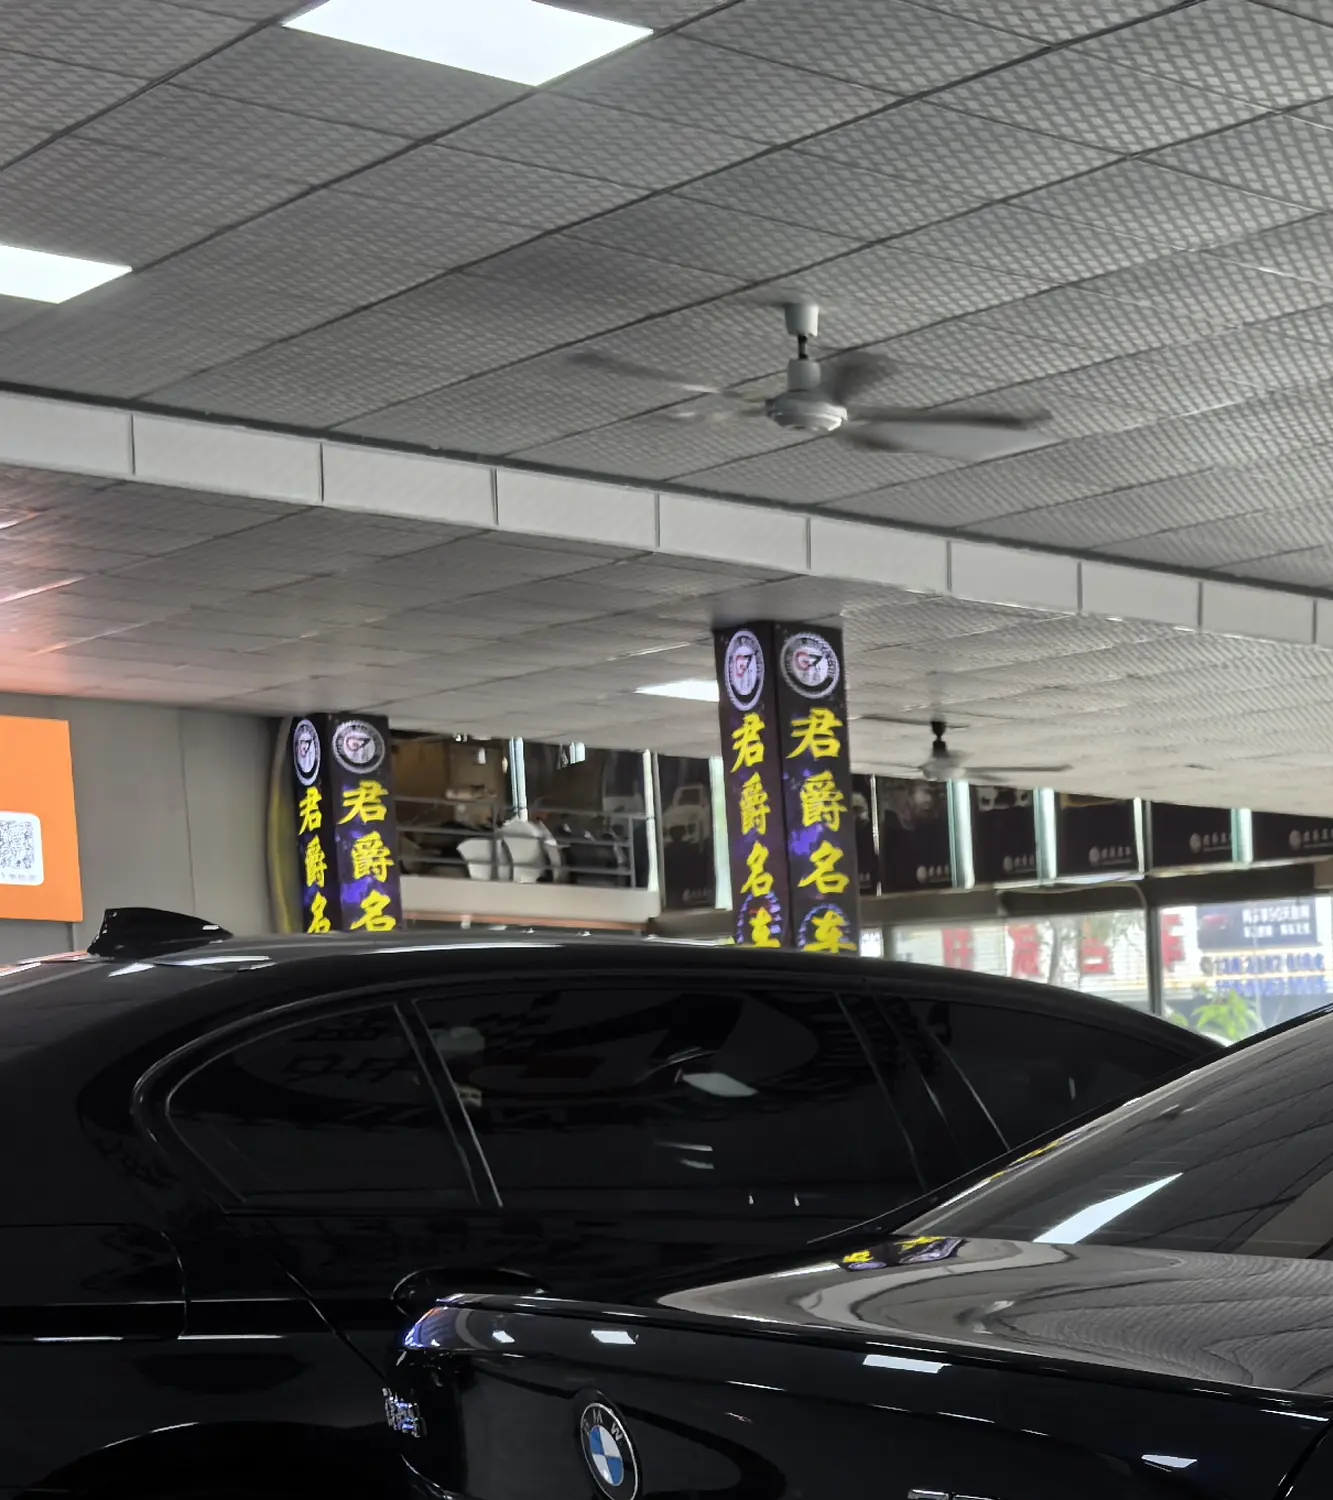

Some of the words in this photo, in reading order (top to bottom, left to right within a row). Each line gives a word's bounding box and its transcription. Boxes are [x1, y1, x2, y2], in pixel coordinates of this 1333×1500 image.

[337, 780, 396, 932] 君爵名
[786, 707, 857, 953] 君爵名车
